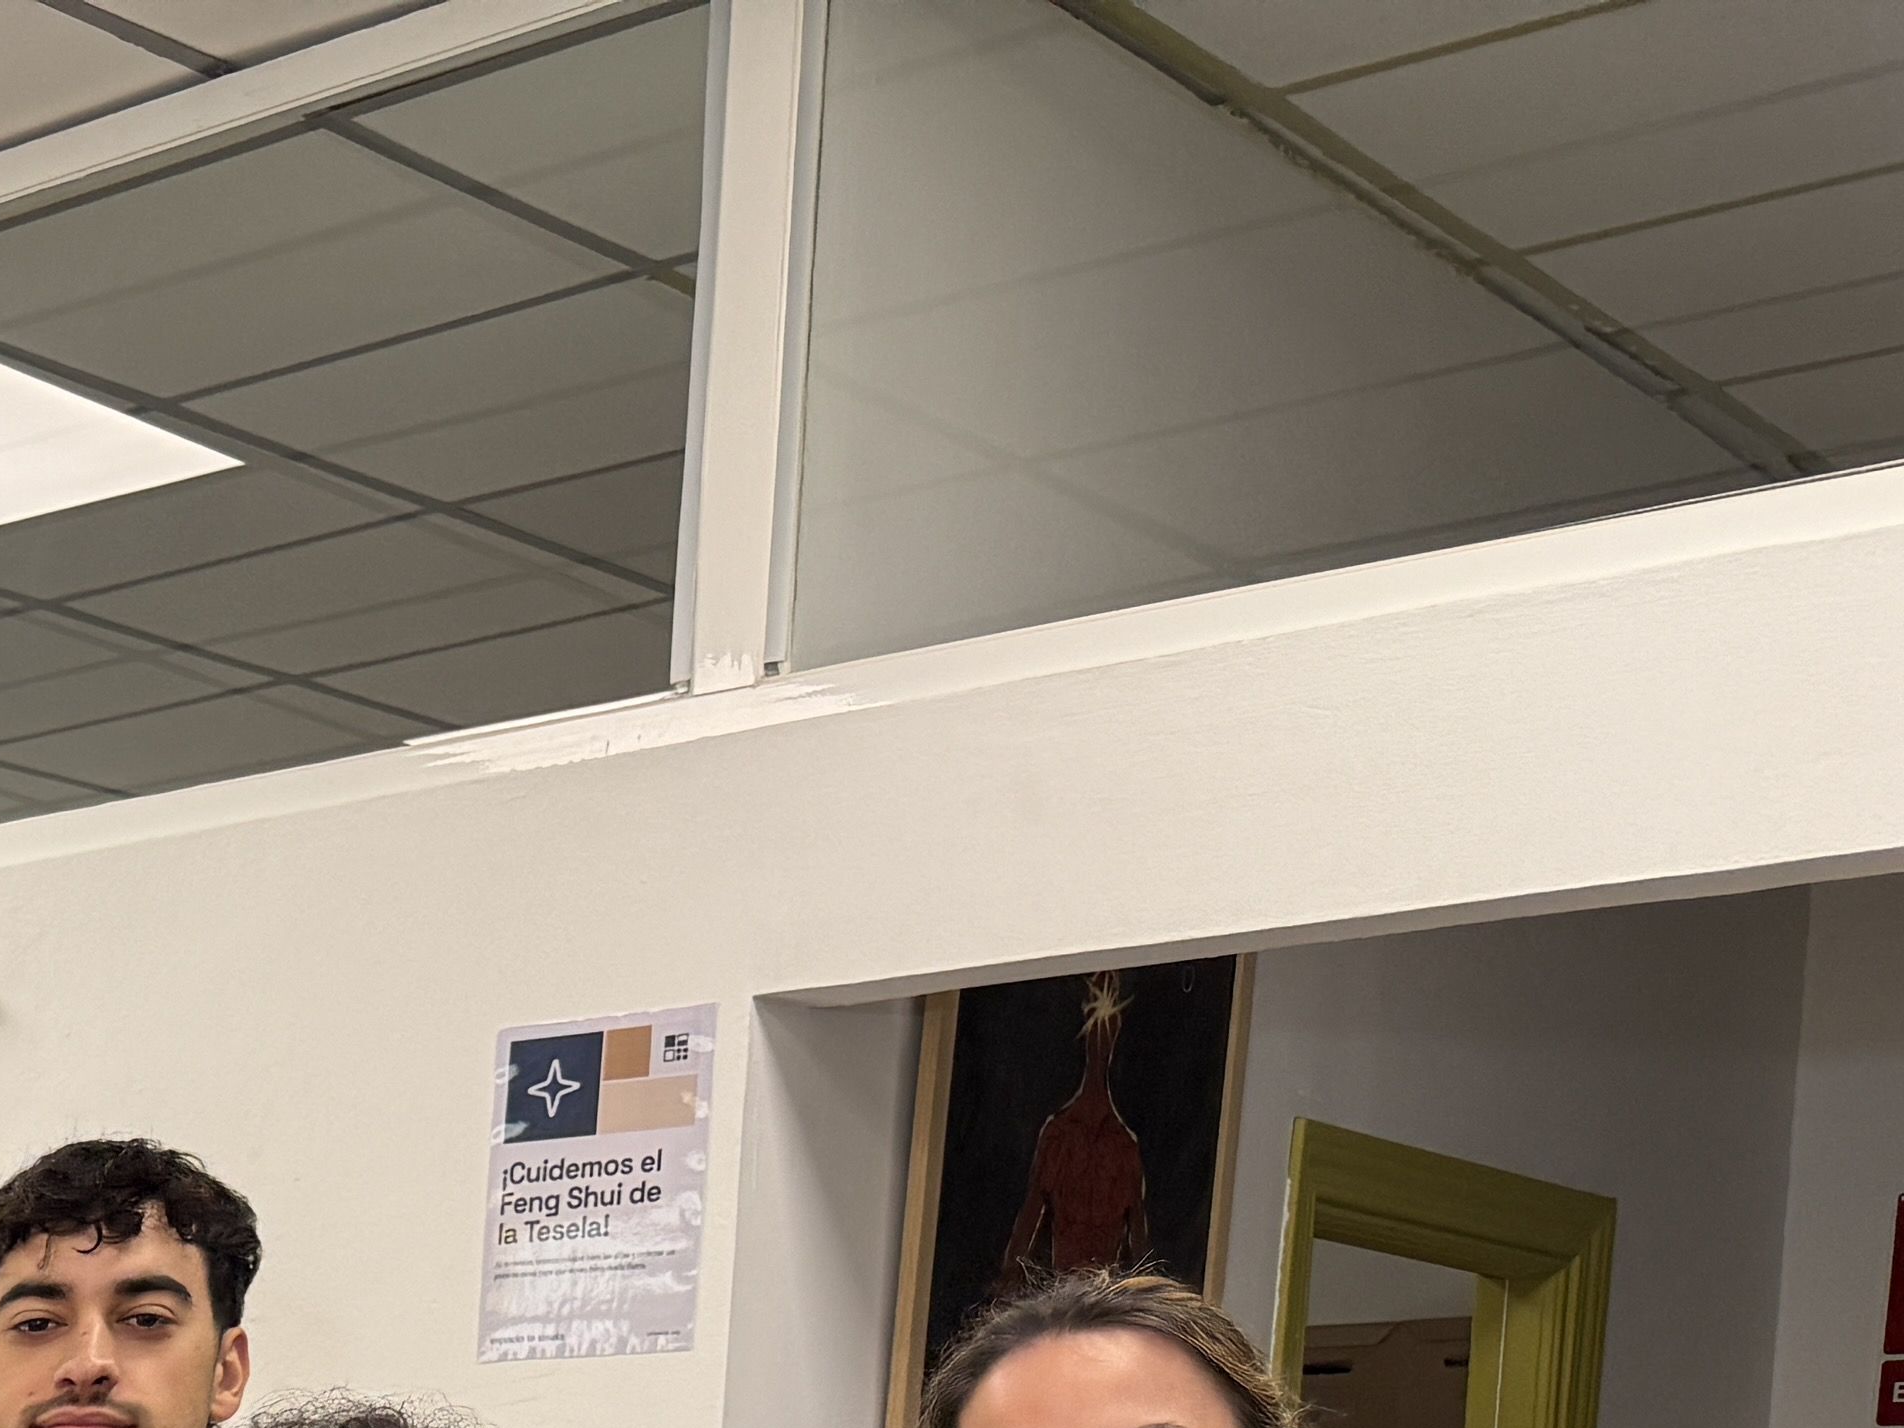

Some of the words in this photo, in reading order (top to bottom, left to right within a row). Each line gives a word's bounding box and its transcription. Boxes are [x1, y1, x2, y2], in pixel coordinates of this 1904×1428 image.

[502, 1157, 634, 1192] ¡Cuidemos
[640, 1148, 663, 1173] el
[500, 1193, 560, 1217] Feng
[567, 1182, 623, 1209] Shui
[629, 1181, 662, 1205] de
[498, 1223, 518, 1245] la
[524, 1214, 610, 1243] Tesela!
